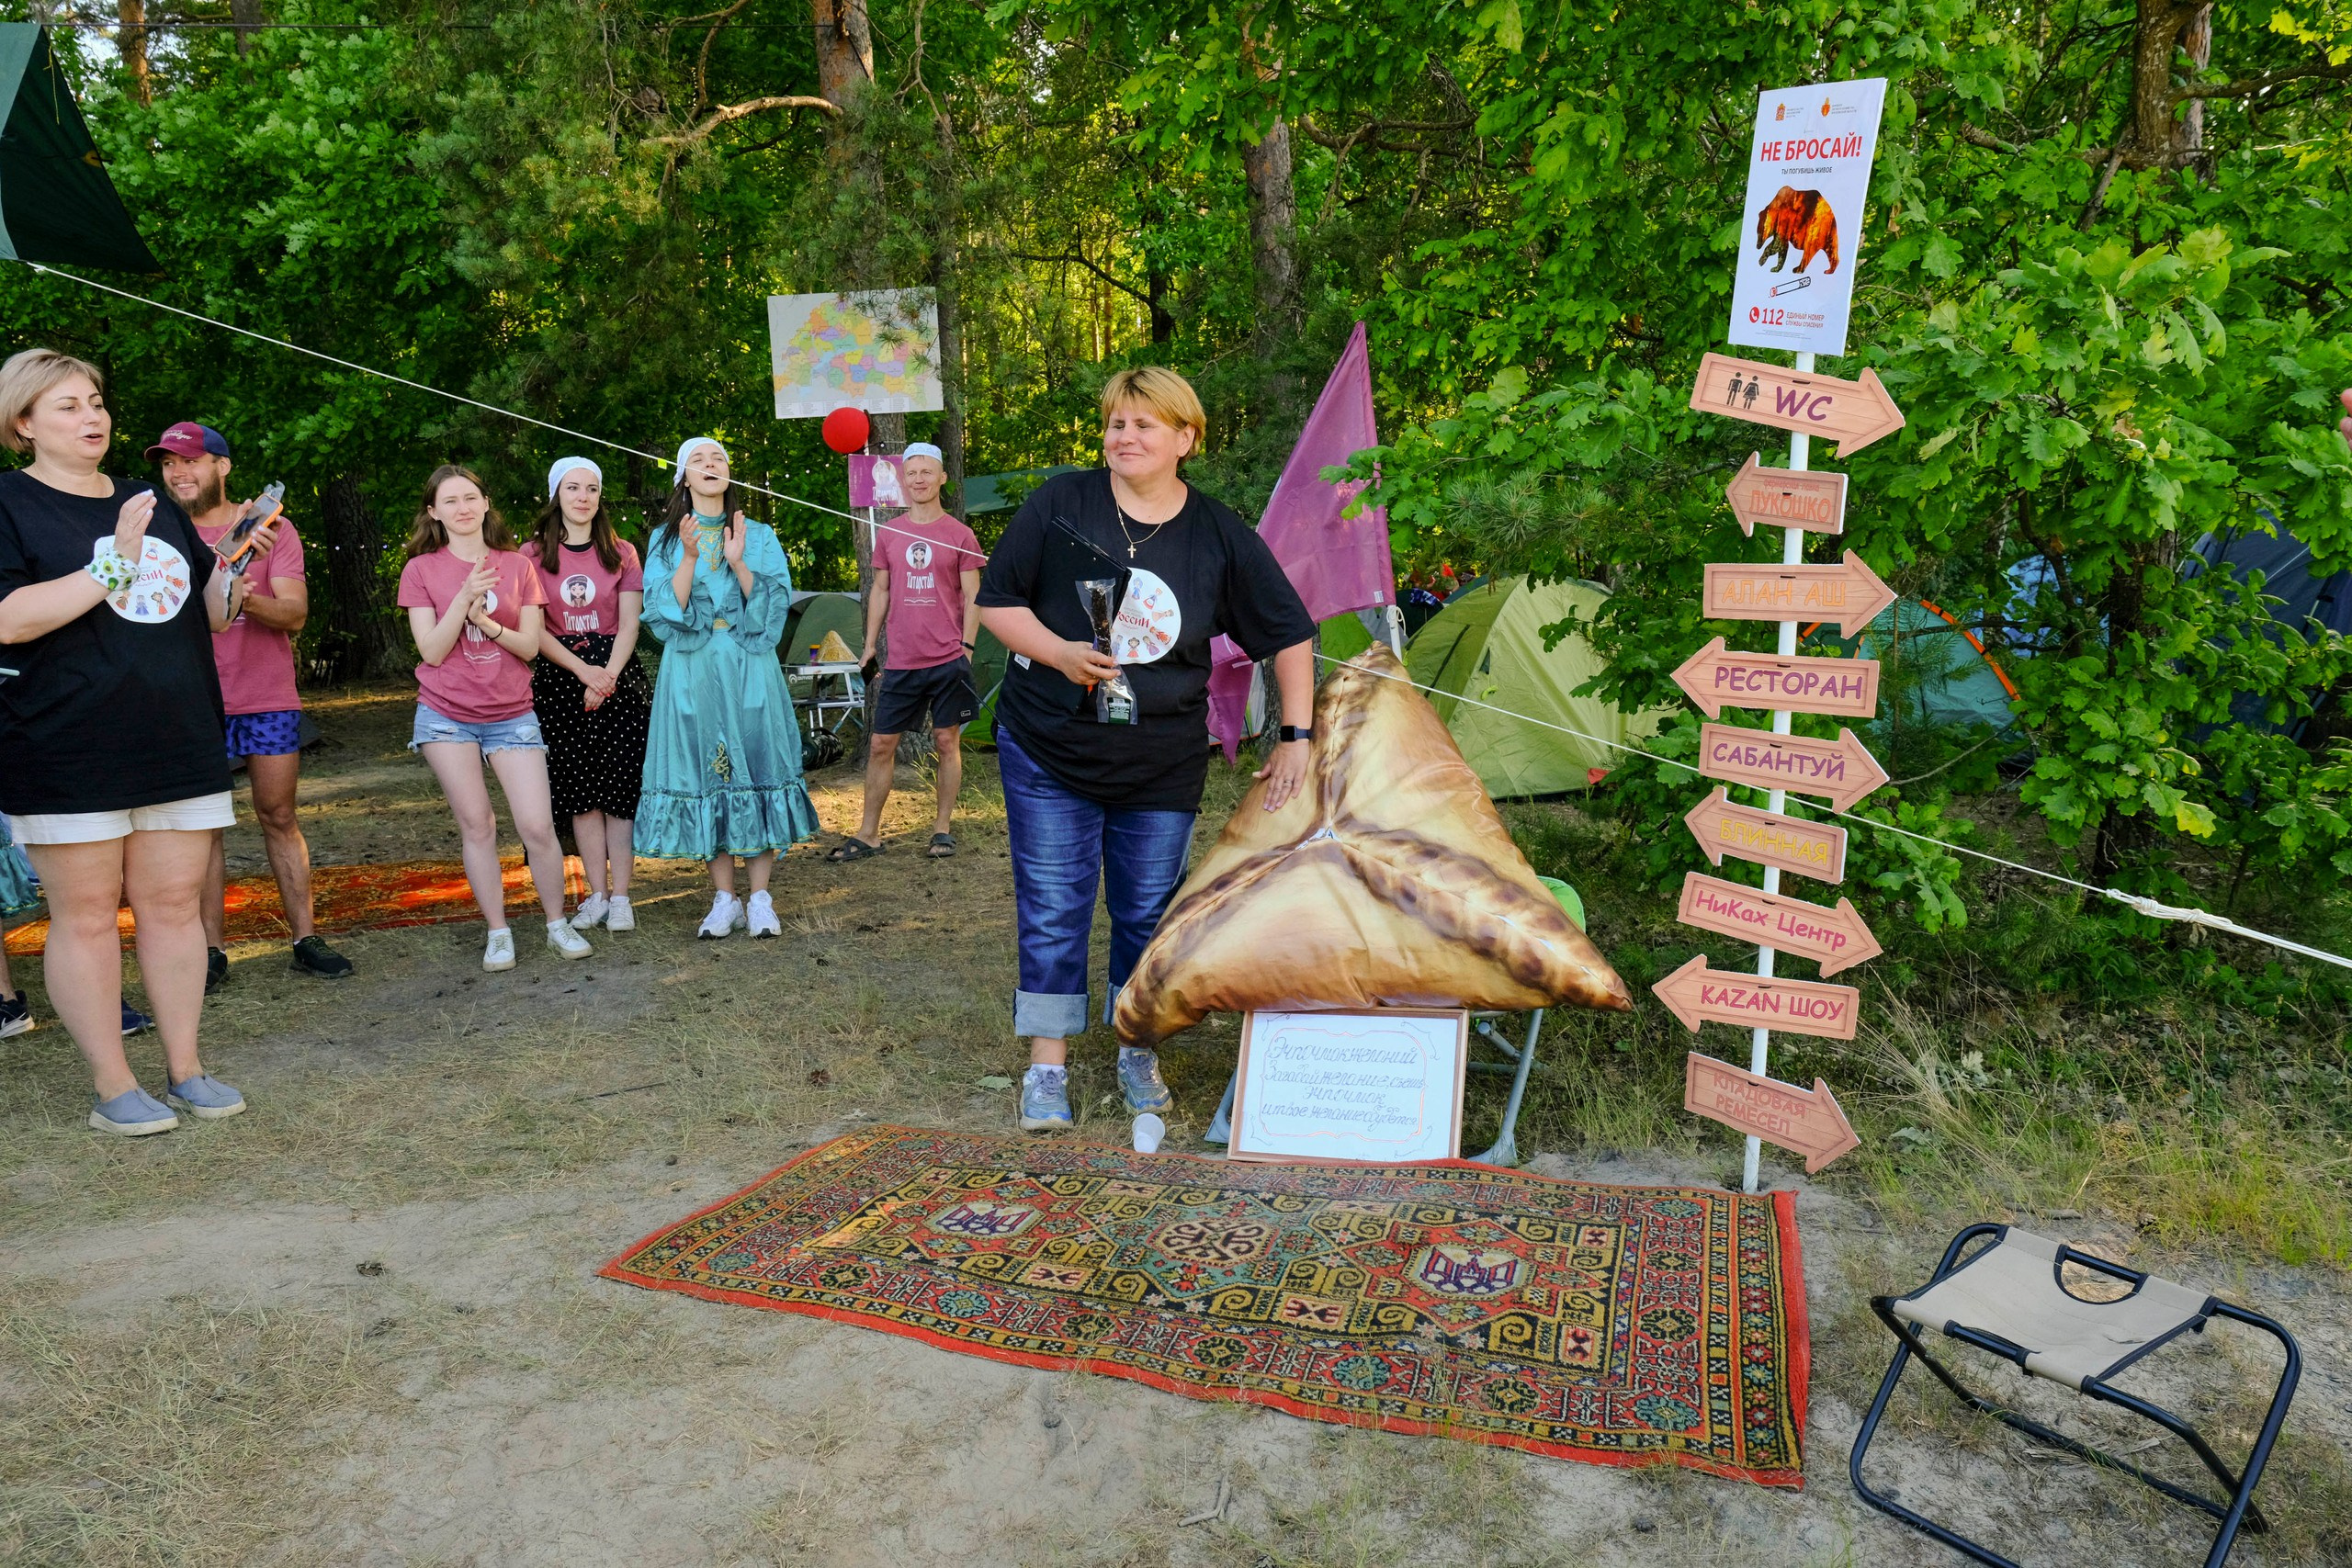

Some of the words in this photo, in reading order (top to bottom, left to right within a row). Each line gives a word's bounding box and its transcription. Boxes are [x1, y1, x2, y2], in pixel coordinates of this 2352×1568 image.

[1760, 141, 1782, 162] НЕ
[1785, 131, 1862, 161] БРОСАЙ!
[1788, 166, 1815, 175] ПОГУБИШЬ
[1761, 308, 1784, 326] 112
[1776, 385, 1833, 422] WC
[1749, 490, 1831, 523] ЛУКОШКО
[1722, 580, 1792, 605] АЛАН
[1804, 581, 1847, 607] АШ
[1714, 666, 1863, 700] РЕСТОРАН
[1713, 742, 1845, 782] САБАНТУЙ
[1719, 818, 1828, 865] БЛИННАЯ
[1777, 912, 1847, 952] Центр
[1701, 984, 1781, 1013] KAZAN
[1789, 996, 1845, 1021] ШОУ
[1713, 1072, 1806, 1119] КЛАДОВАЯ
[1715, 1094, 1791, 1135] РЕМЕСЕЛ
